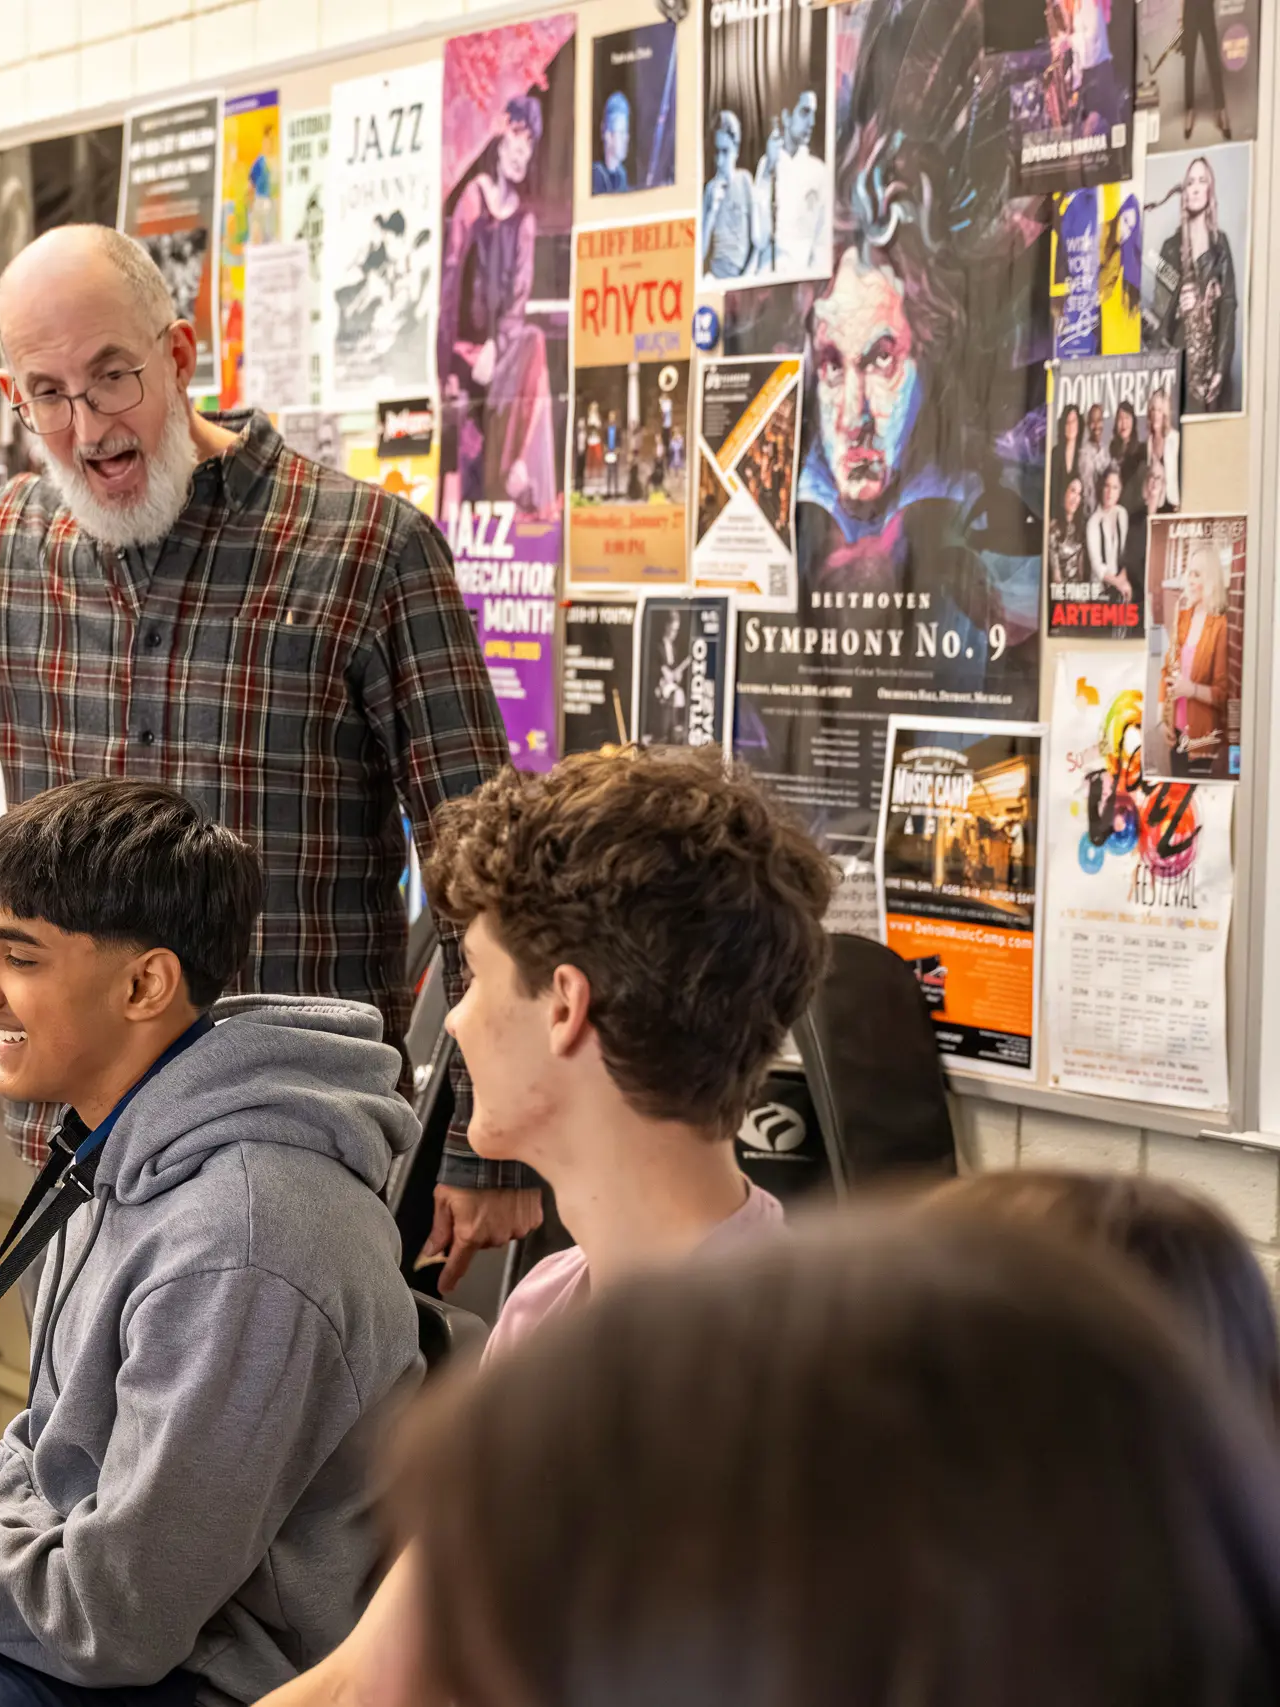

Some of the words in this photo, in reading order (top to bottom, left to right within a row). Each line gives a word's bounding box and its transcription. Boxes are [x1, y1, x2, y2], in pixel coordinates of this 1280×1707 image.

[346, 102, 424, 165] JAZZ
[1059, 141, 1072, 158] ON
[1073, 133, 1107, 155] YAMAHA
[577, 229, 626, 260] CLIFF
[631, 217, 695, 254] BELL'S
[1057, 369, 1176, 418] DOWNBEAT
[1169, 522, 1204, 538] LAURA
[483, 598, 555, 634] MONTH
[811, 592, 931, 609] BEETHOVEN
[1051, 603, 1139, 627] ARTEMIS
[744, 616, 904, 656] SYMPHONY
[988, 623, 1007, 661] 9
[892, 767, 933, 805] MUSIC
[934, 772, 973, 810] CAMP
[1134, 863, 1198, 909] FESTIVAL
